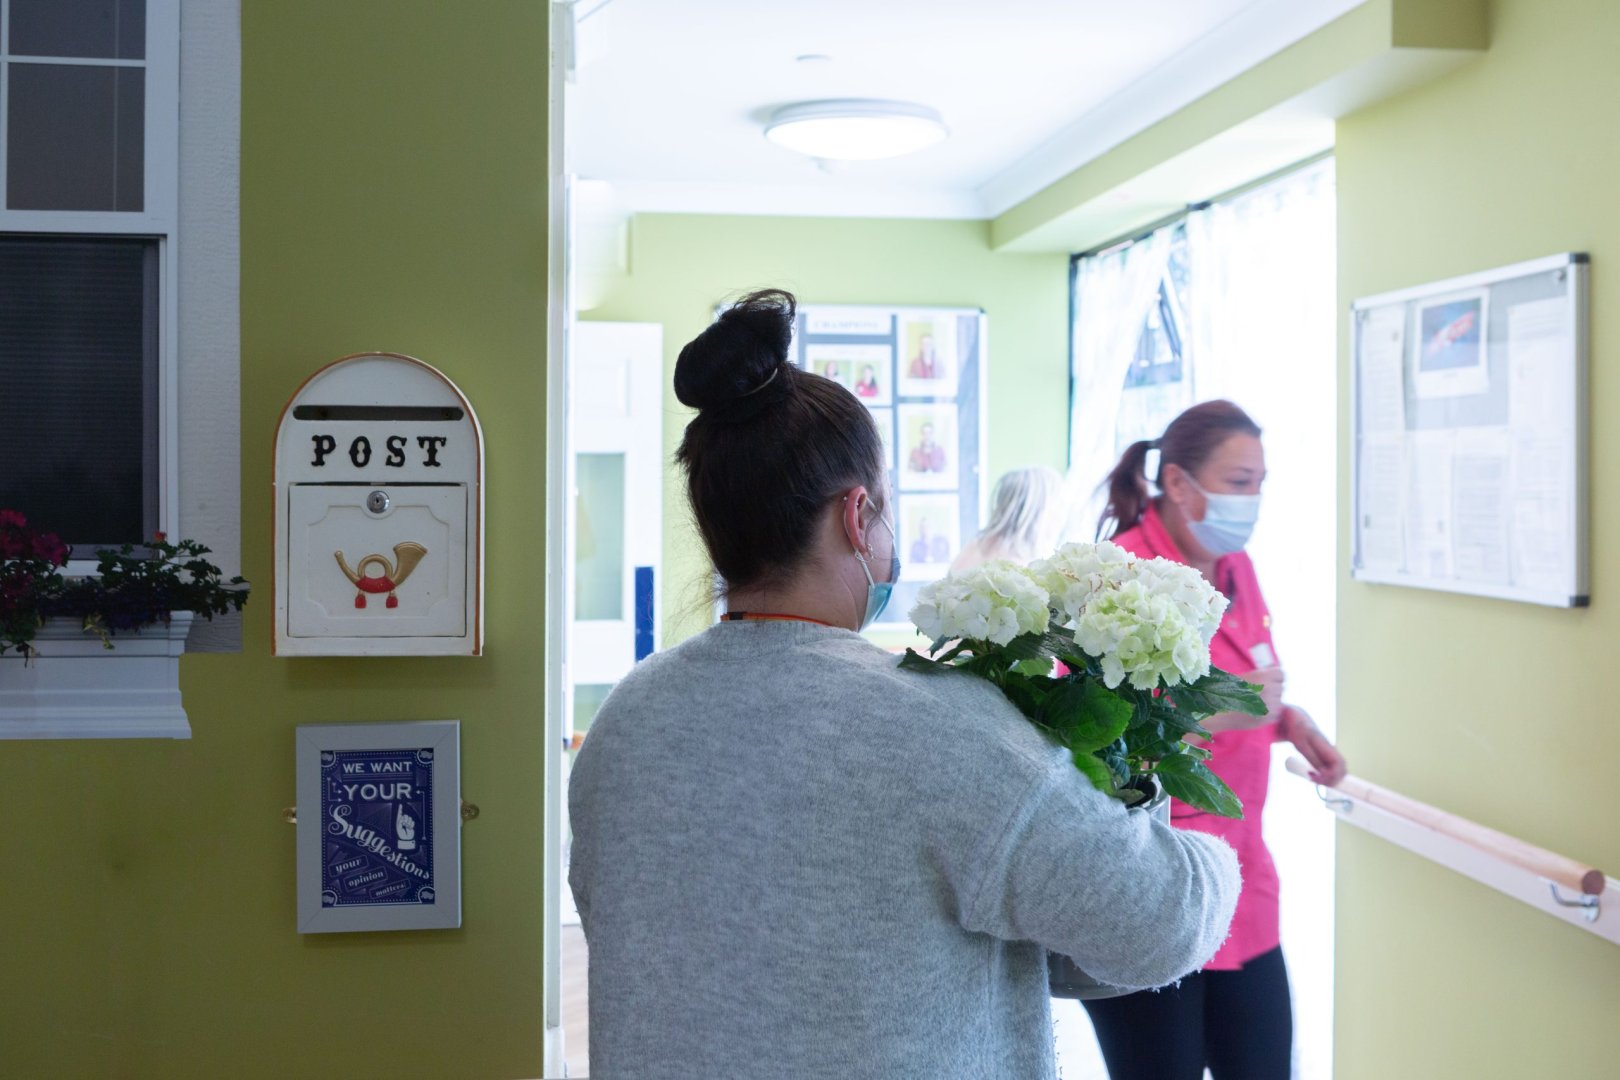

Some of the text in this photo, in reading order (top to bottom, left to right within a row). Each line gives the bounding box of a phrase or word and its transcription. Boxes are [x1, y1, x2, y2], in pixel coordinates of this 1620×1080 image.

[311, 434, 447, 468] POST
[342, 761, 413, 774] WE WANT
[342, 782, 412, 801] YOUR
[327, 804, 430, 880] Suggestions
[335, 859, 362, 873] your
[348, 871, 384, 888] opinion
